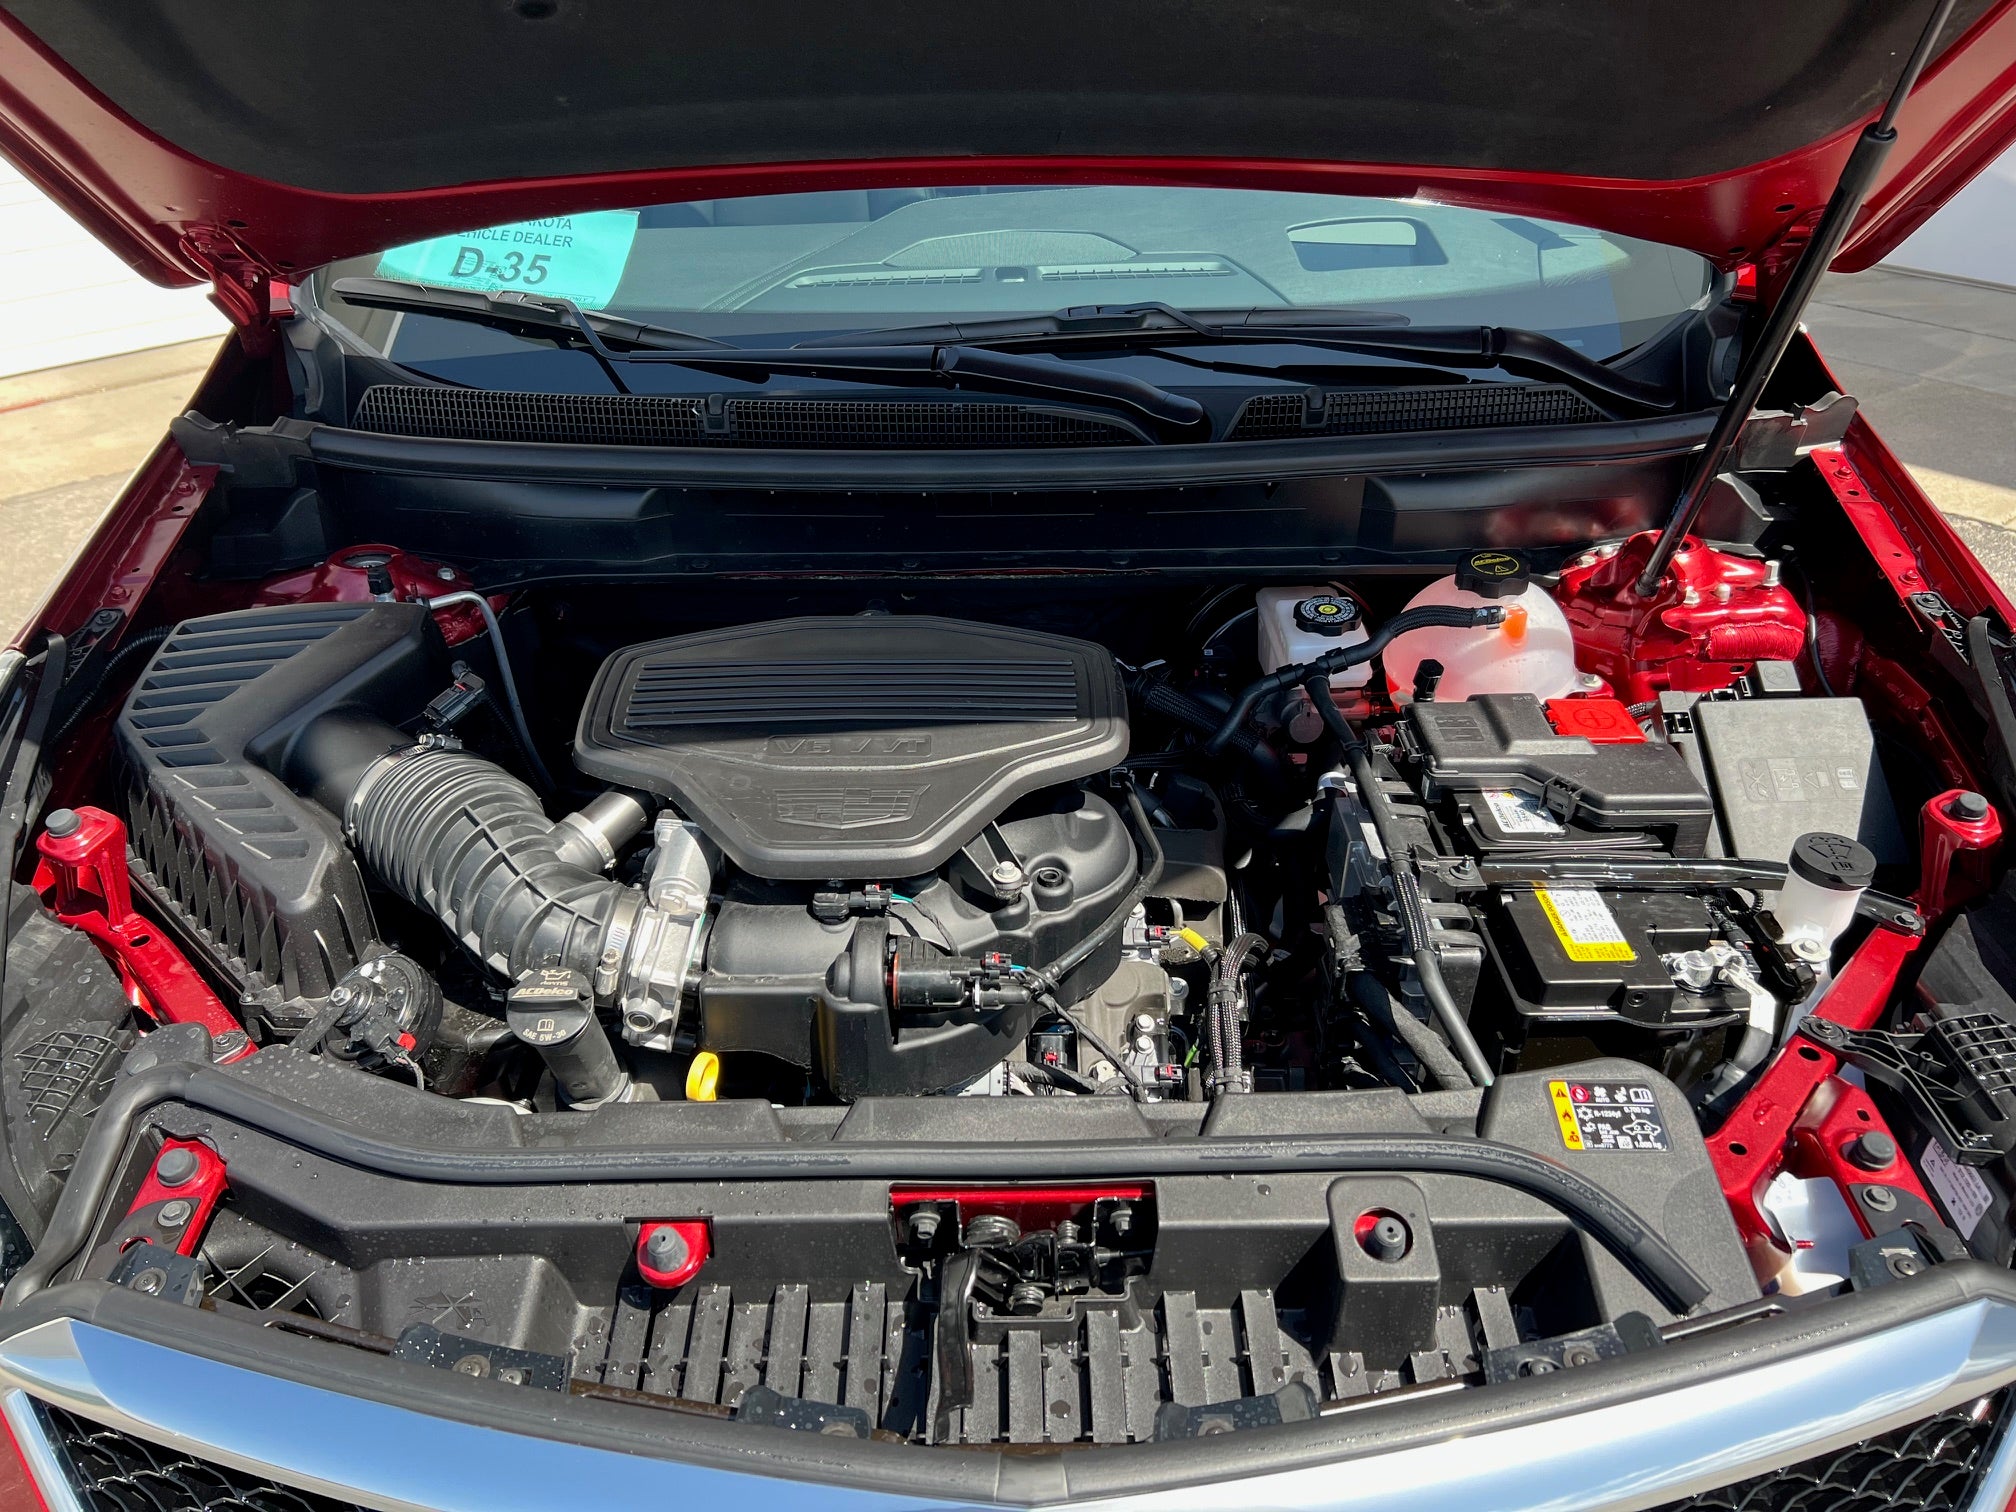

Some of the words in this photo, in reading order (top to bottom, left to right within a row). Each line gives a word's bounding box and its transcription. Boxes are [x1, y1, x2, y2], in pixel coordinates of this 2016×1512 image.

[513, 230, 574, 249] DEALER
[449, 246, 552, 285] D-35
[514, 987, 574, 996] ACDelco
[522, 1028, 538, 1040] SAE
[539, 1029, 567, 1042] 5W-30
